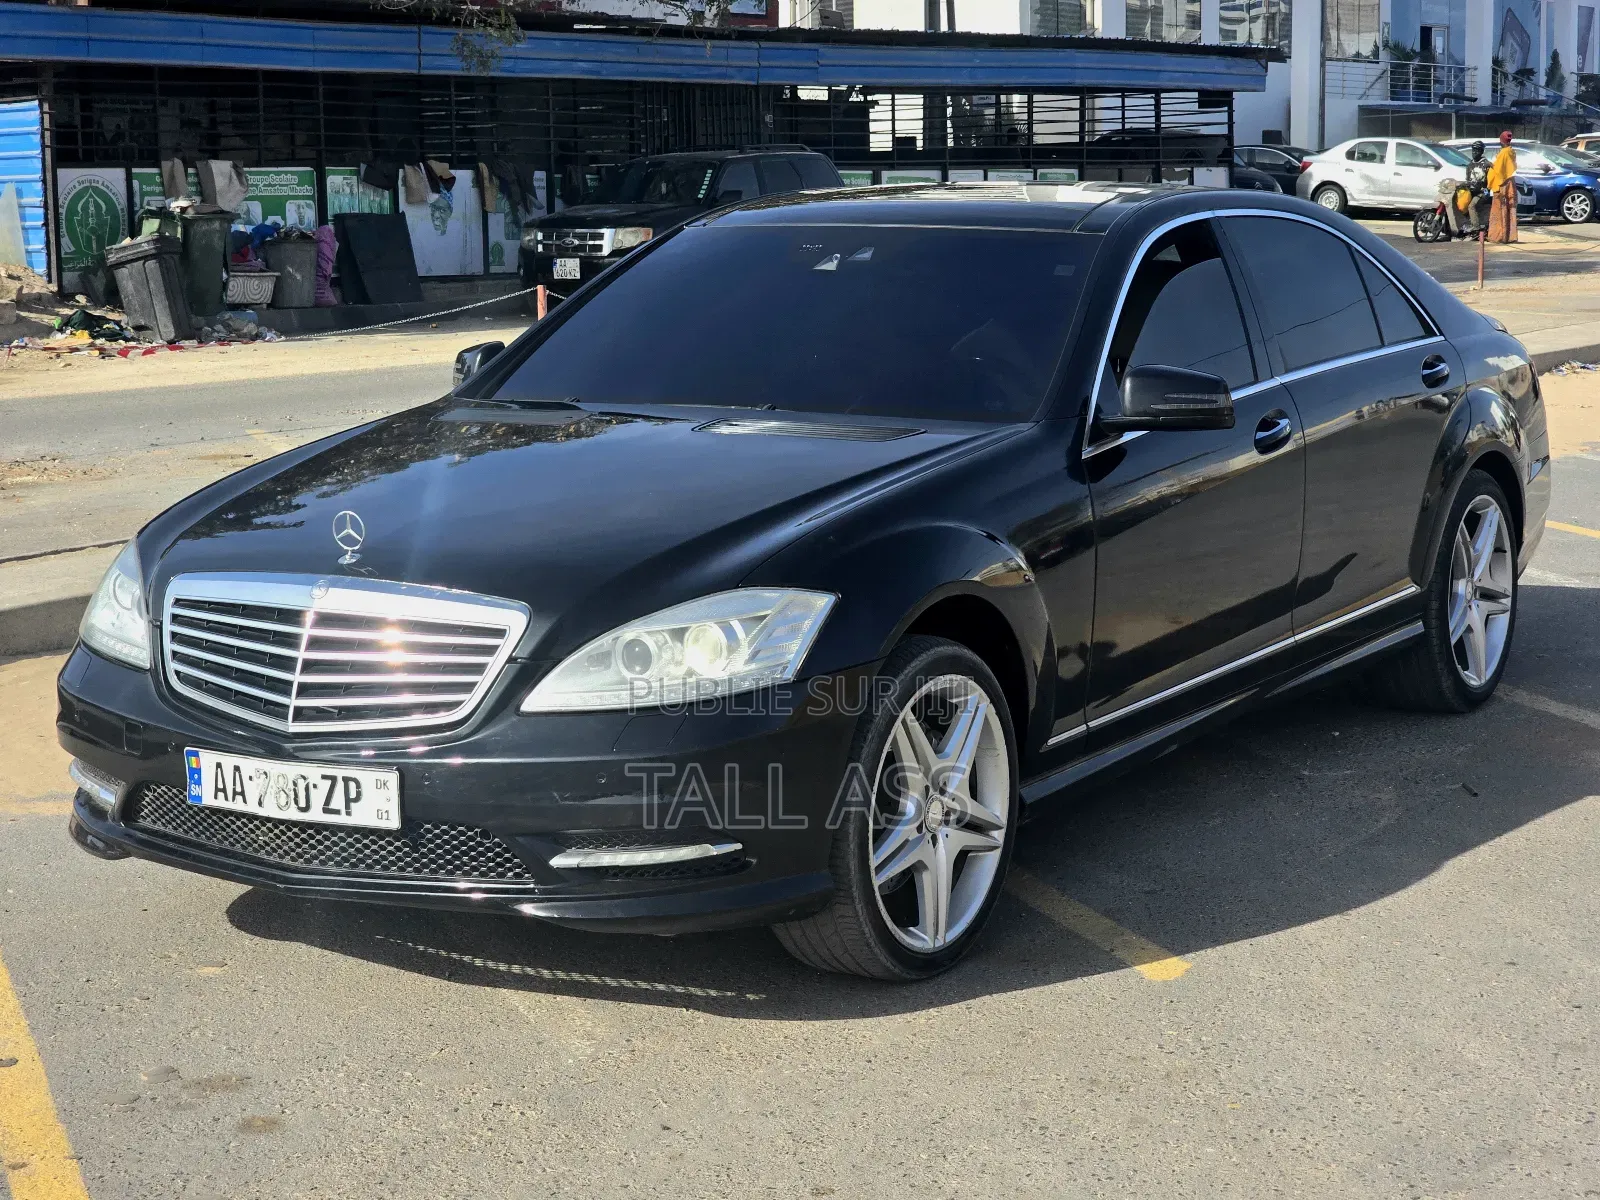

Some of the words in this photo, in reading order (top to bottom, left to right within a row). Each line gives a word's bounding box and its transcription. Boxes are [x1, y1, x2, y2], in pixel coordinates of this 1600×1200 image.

[270, 174, 298, 184] Scolaire
[258, 185, 287, 195] Amsatou
[289, 186, 313, 195] Mbacke
[375, 778, 390, 791] DK
[190, 784, 202, 797] SN
